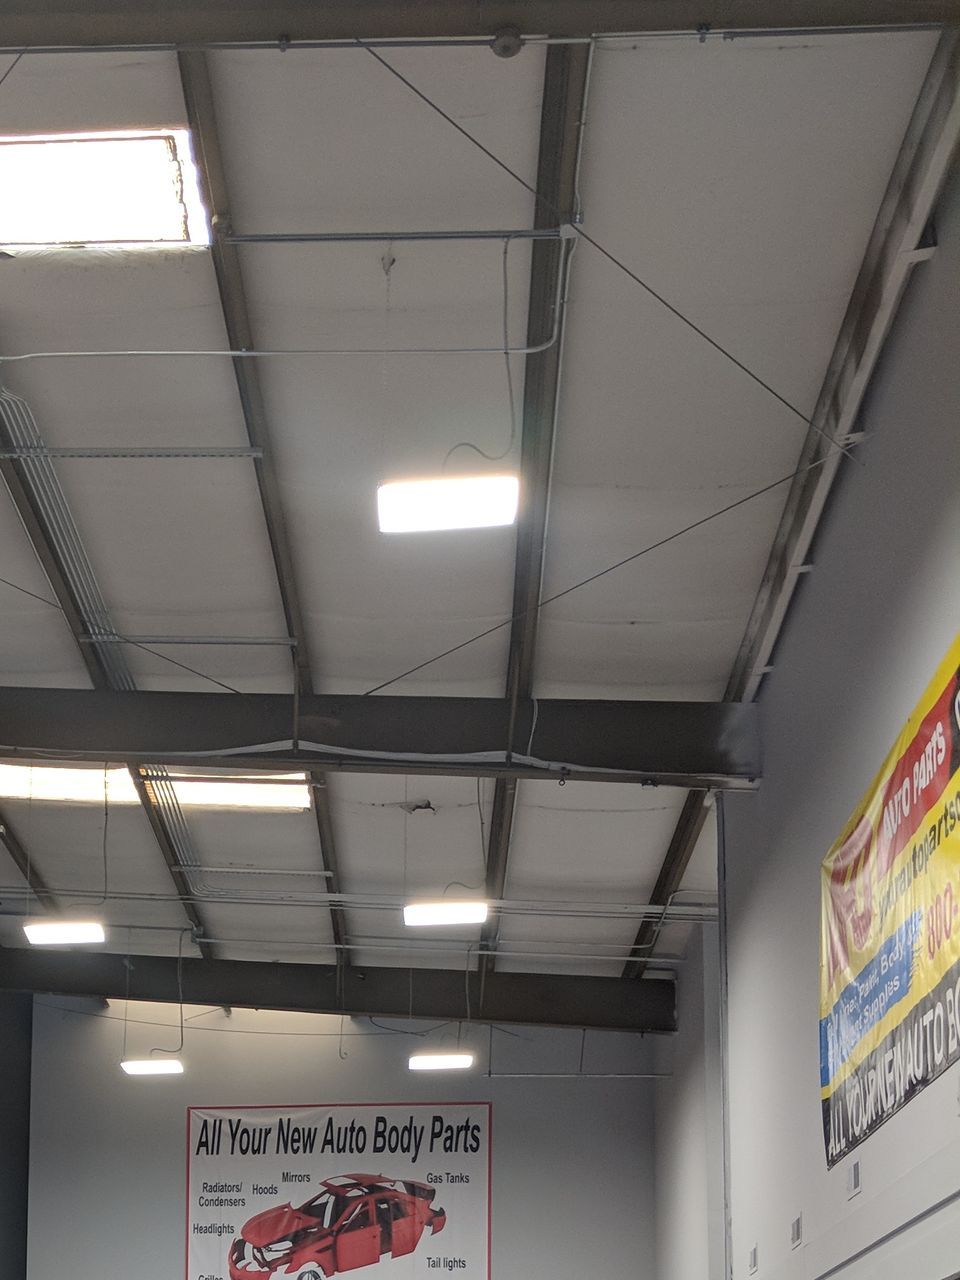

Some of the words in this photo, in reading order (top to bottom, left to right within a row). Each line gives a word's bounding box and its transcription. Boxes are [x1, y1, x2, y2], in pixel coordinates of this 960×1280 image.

[883, 777, 910, 843] AUTO
[913, 721, 947, 805] PARTS
[828, 1098, 846, 1158] ALL
[845, 1068, 876, 1138] YOUR
[876, 1038, 905, 1110] NEW
[905, 1002, 944, 1083] AUTO
[195, 1118, 222, 1155] All
[228, 1118, 272, 1155] Your
[275, 1117, 317, 1154] New
[321, 1116, 367, 1153] Auto
[372, 1116, 425, 1163] Body
[429, 1115, 481, 1153] Parts
[281, 1171, 311, 1183] Mirrors
[426, 1172, 443, 1184] Gas
[445, 1172, 470, 1184] Tanks
[202, 1182, 242, 1193] Radiators/
[252, 1183, 278, 1195] Hoods
[198, 1196, 246, 1207] Condensers
[192, 1223, 235, 1236] Headlights
[426, 1257, 441, 1268] Tail
[443, 1257, 467, 1271] lights
